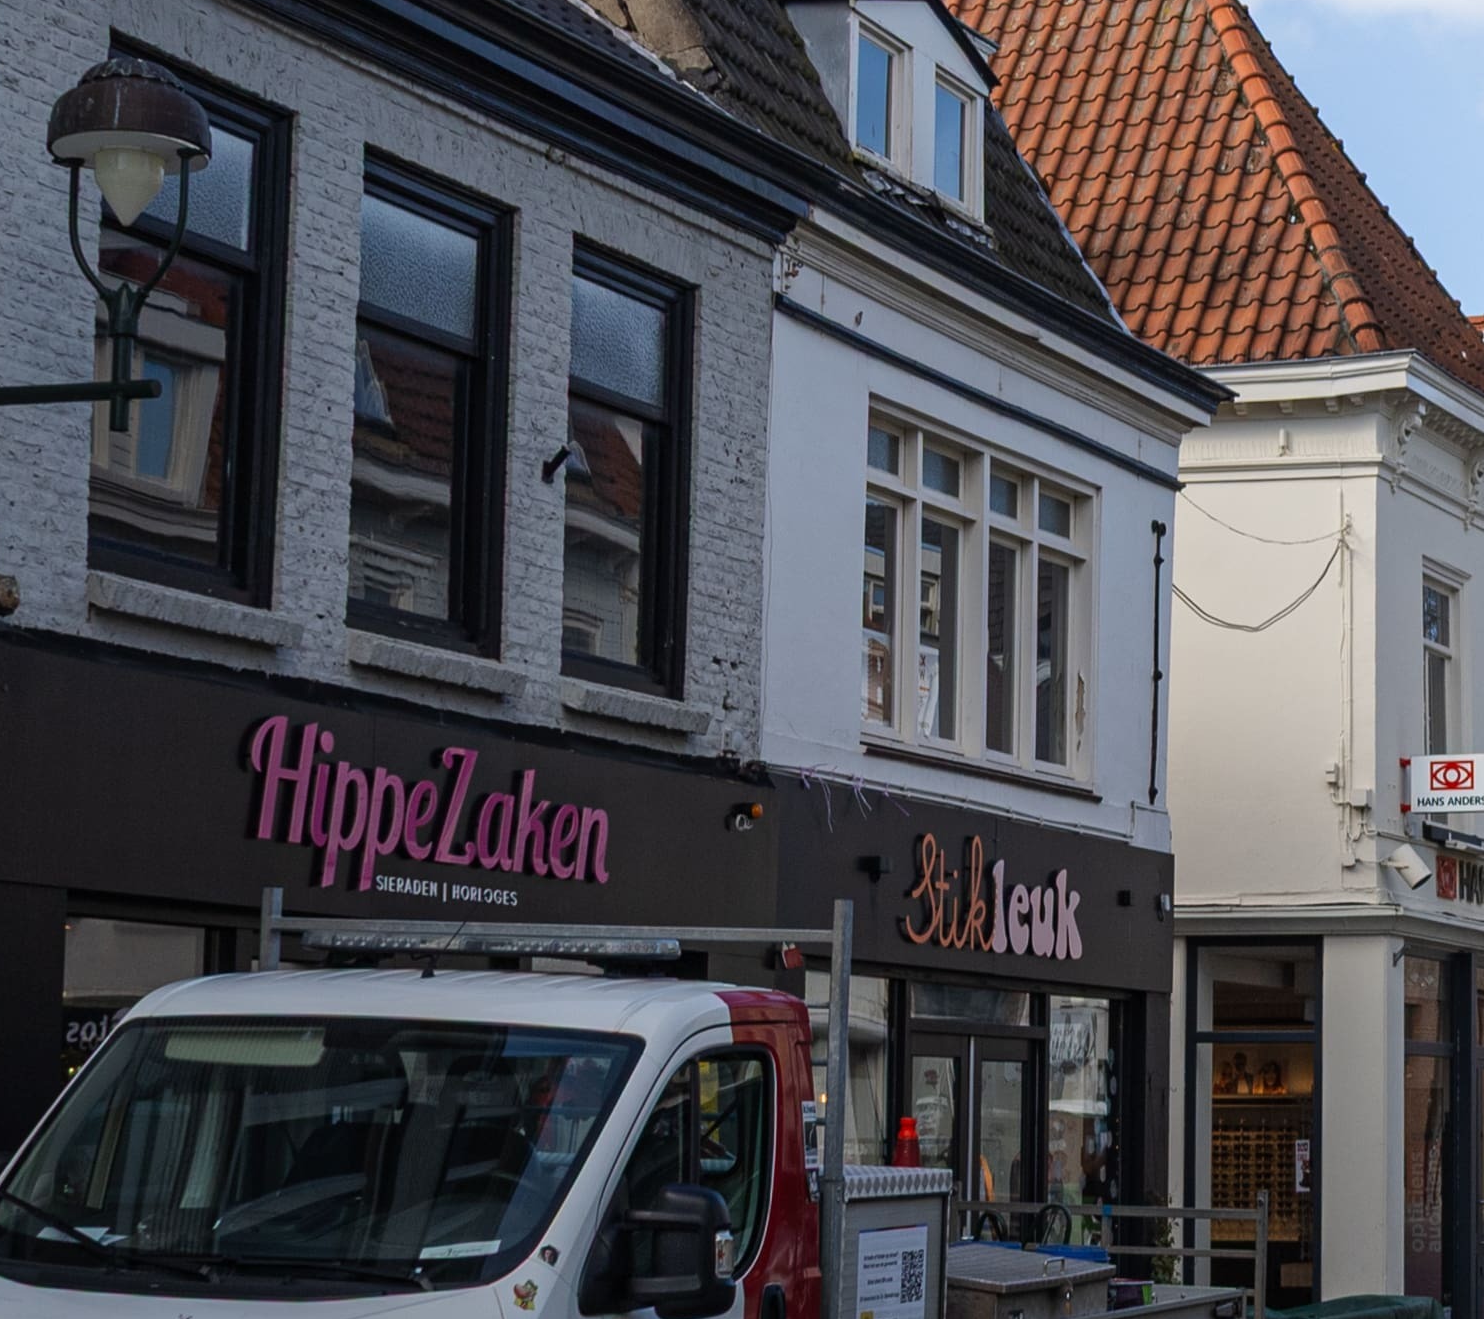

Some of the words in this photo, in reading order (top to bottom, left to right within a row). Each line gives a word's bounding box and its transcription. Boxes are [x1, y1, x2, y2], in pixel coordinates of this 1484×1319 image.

[250, 715, 610, 893] HippeZaken
[1417, 796, 1445, 807] HANS
[375, 874, 438, 898] SIERADEN
